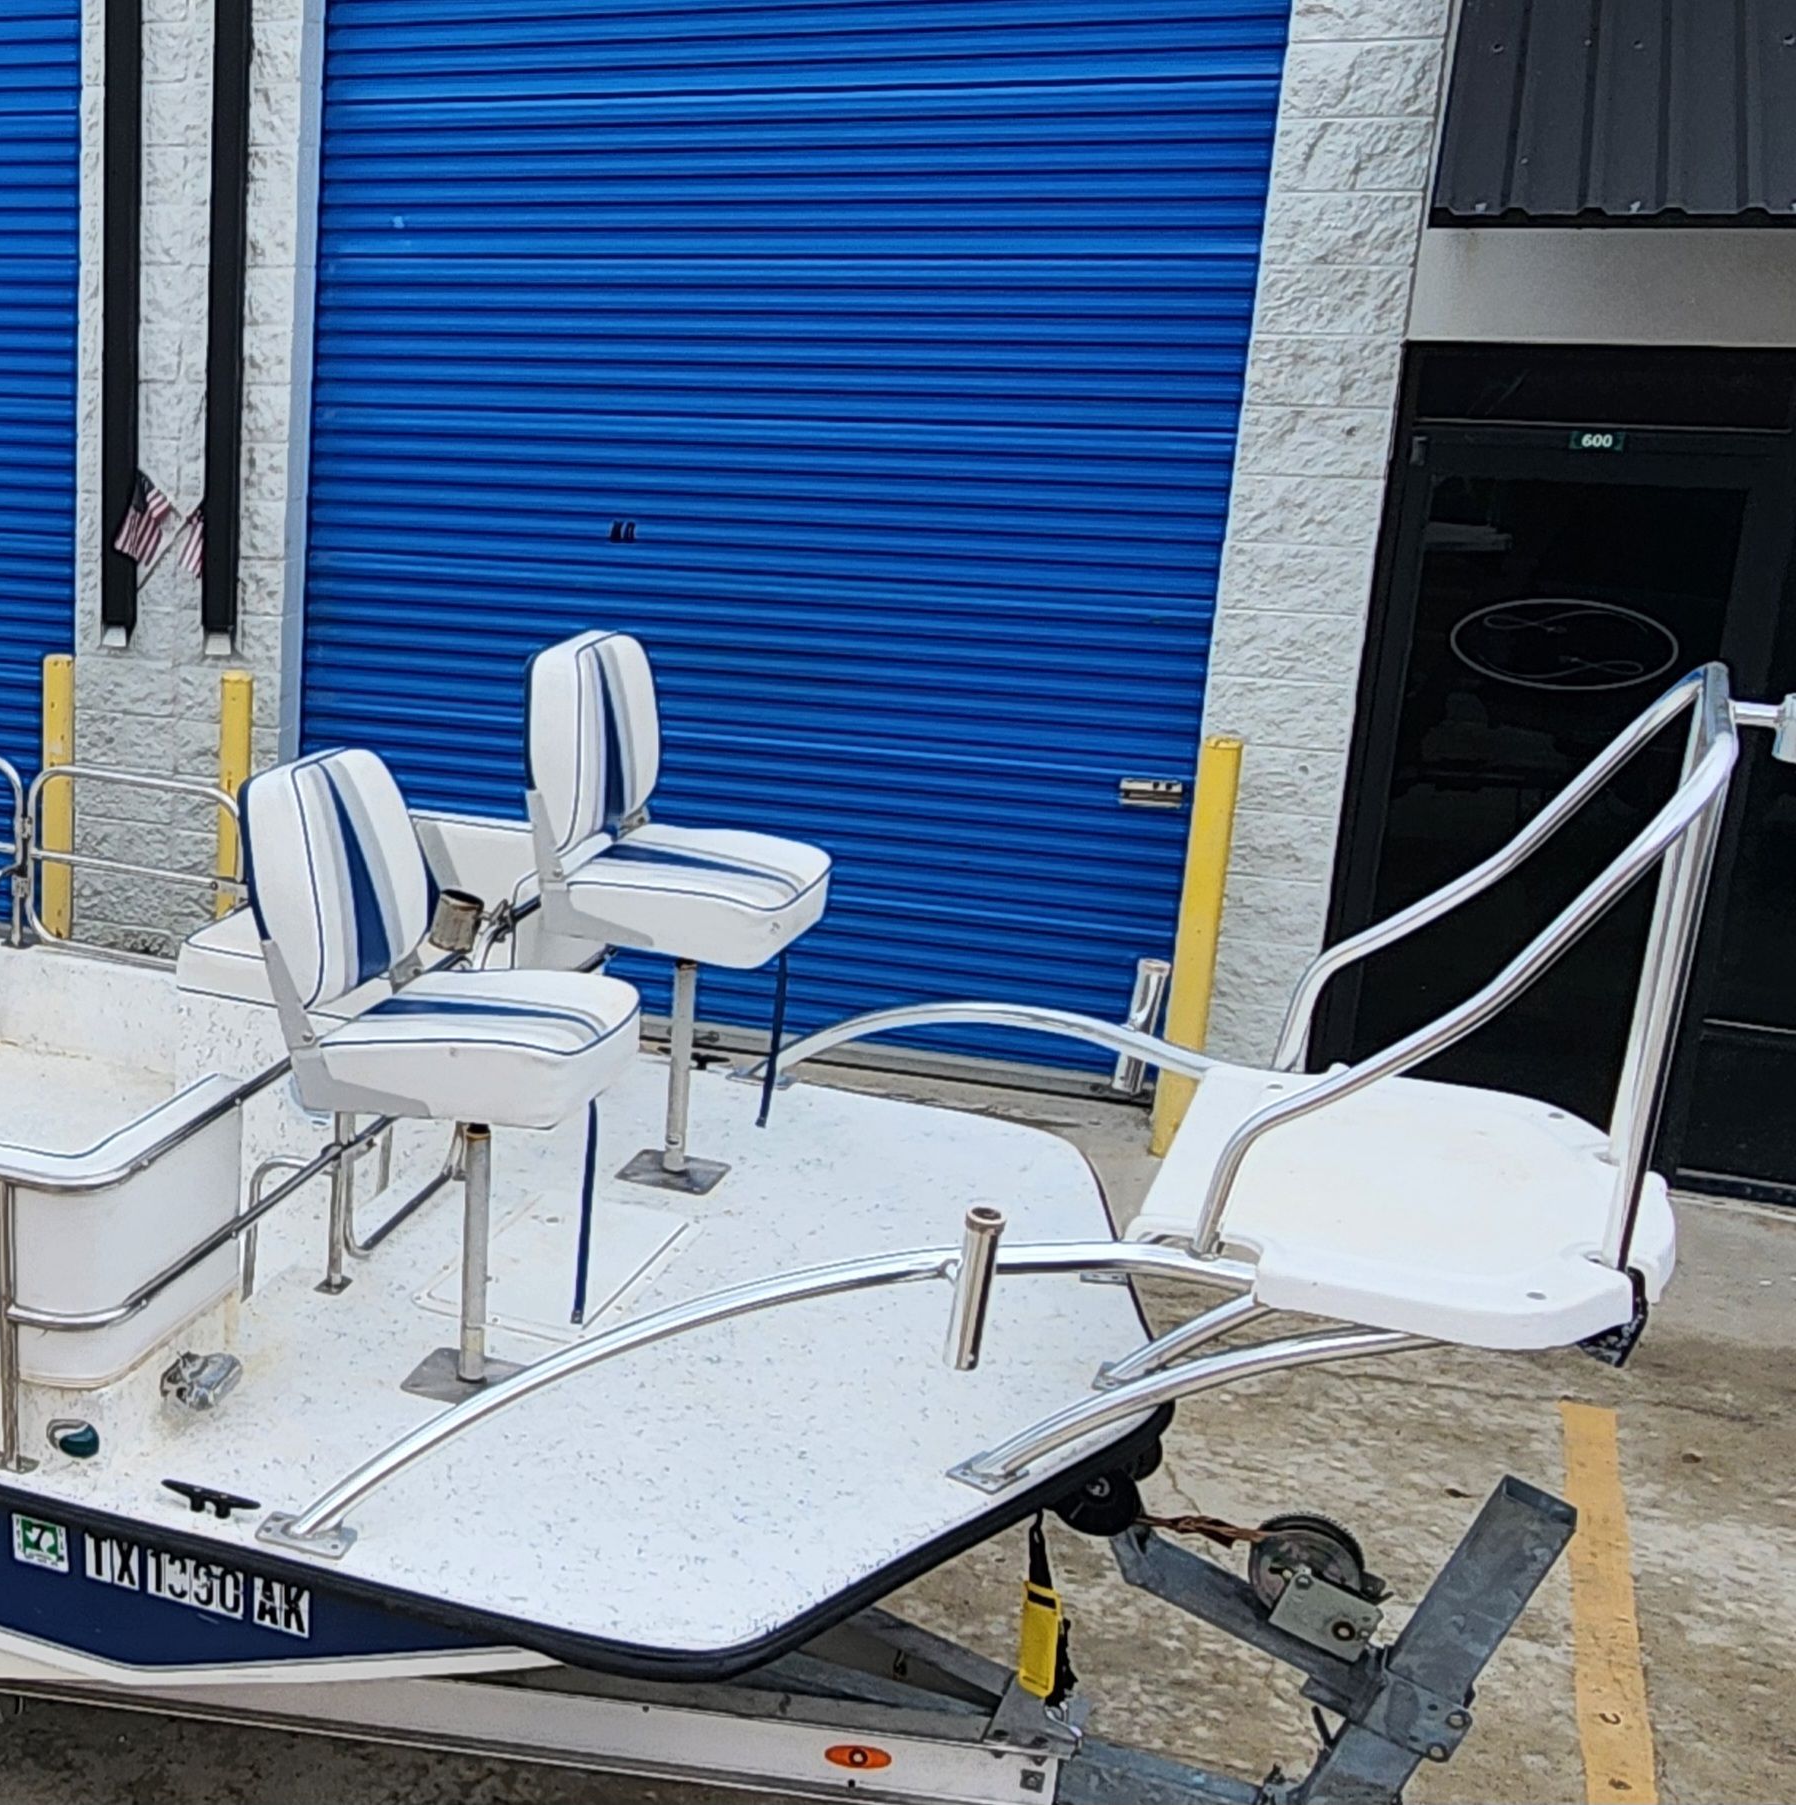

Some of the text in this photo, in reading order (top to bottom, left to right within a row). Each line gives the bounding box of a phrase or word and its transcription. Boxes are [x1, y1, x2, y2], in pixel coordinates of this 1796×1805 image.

[1581, 433, 1613, 448] 600
[89, 1537, 136, 1588] TX
[257, 1578, 306, 1635] AK
